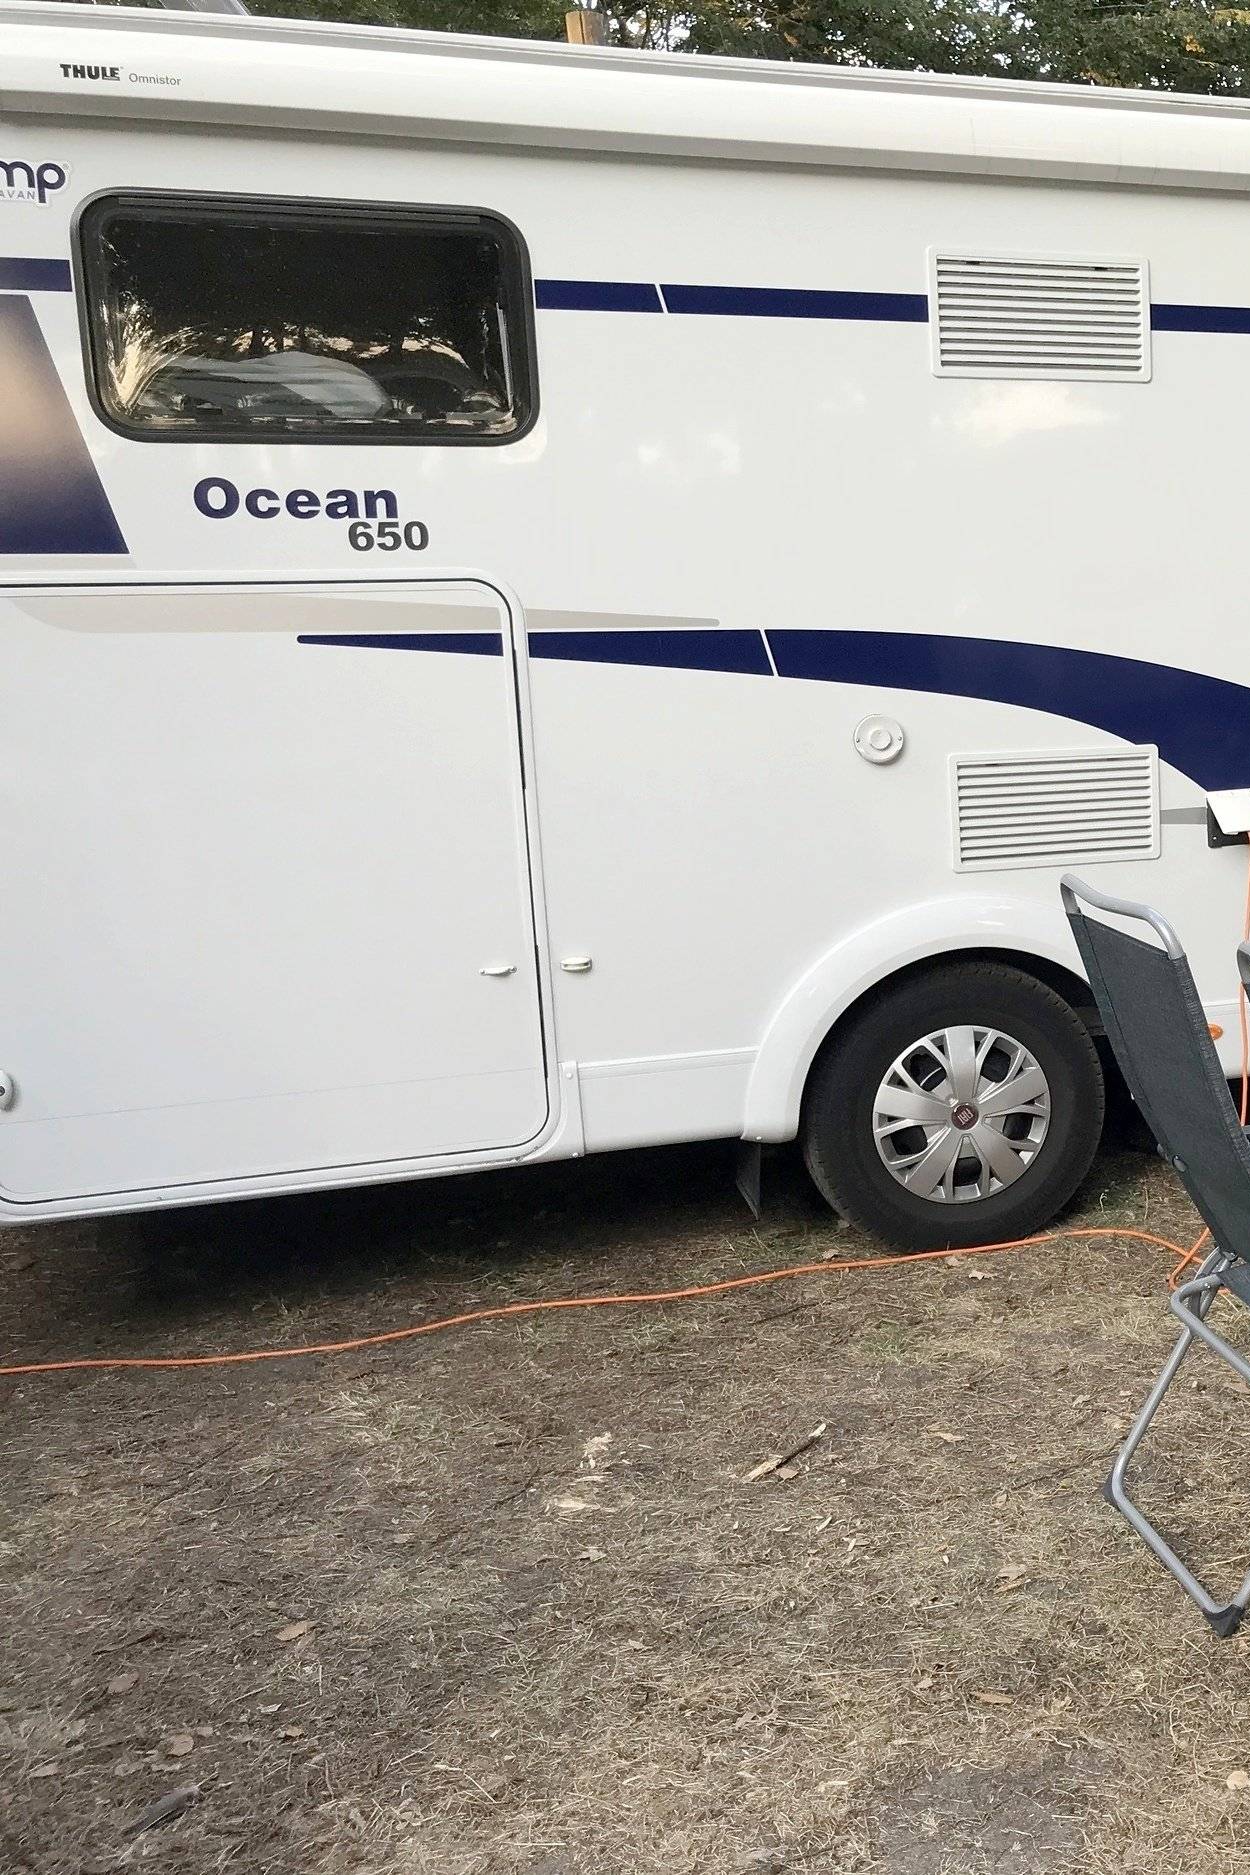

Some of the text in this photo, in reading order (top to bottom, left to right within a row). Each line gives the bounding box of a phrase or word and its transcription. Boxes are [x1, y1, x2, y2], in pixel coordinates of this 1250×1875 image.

[59, 63, 182, 86] THULE Omnistor
[193, 476, 399, 519] Ocean
[348, 520, 430, 552] 650
[957, 1107, 974, 1125] FIAT
